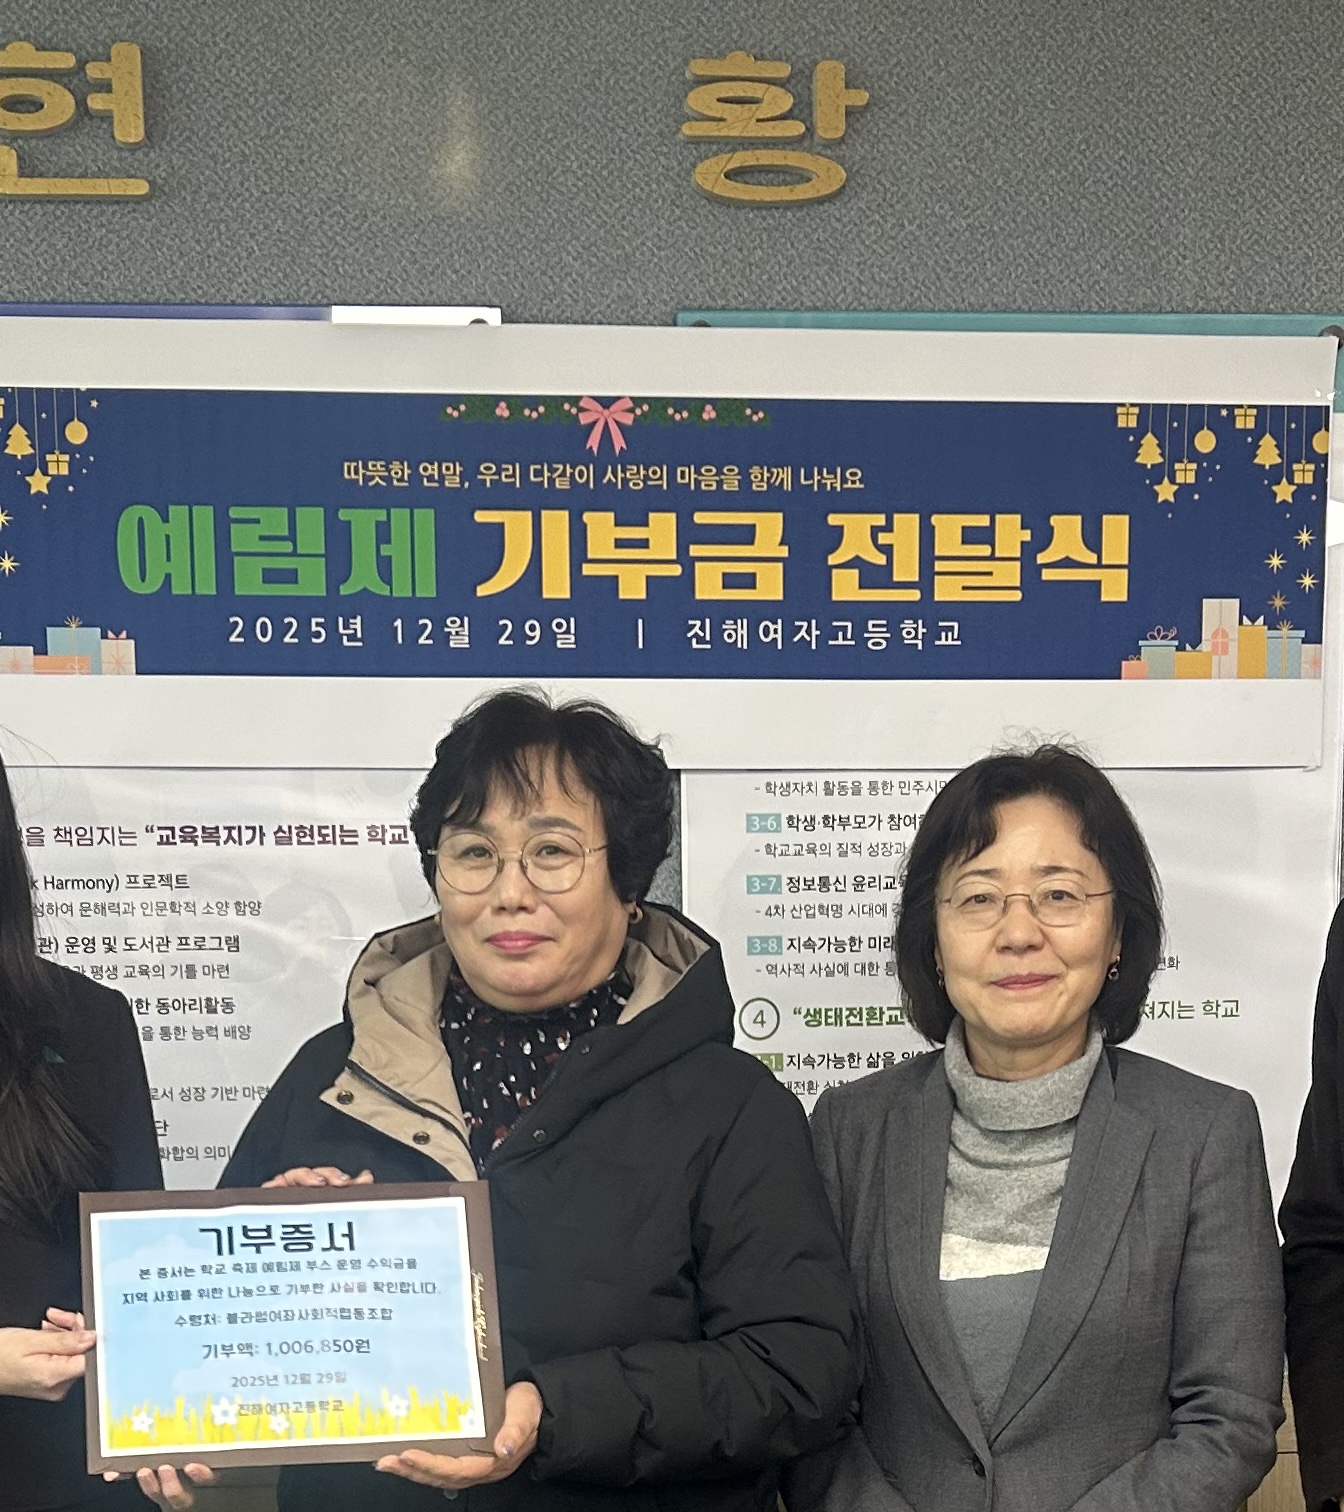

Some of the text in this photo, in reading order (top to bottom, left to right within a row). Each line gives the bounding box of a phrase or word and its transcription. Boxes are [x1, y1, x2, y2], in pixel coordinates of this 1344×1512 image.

[680, 50, 870, 202] 황
[343, 460, 865, 492] 따뜻한 연말, 우리 다같이 사랑의 마음을 함께 나눠요
[115, 503, 1131, 603] 예림제 기부금 전달식
[228, 614, 962, 651] 2025년 12월 29일 진해여자고등학교
[764, 780, 895, 797] 학생자치 활동을 통한
[751, 813, 883, 832] 3-6. 학생·학부모가
[53, 825, 138, 847] 책임지는
[273, 824, 359, 847] 실현되는
[764, 841, 907, 858] 학교교육의 질적 성장과
[44, 873, 190, 893] Harmony) 프로젝트
[751, 874, 847, 893] 3-7. 정보통신
[78, 900, 262, 918] 문해력과 인문학적 소양 함양
[764, 903, 786, 919] 4차
[790, 903, 843, 919] 산업혁명
[848, 903, 888, 919] 시대에
[64, 934, 241, 954] 운영 및 도서관 프로그램
[751, 936, 863, 954] 3-8. 지속가능한
[90, 963, 119, 981] 평생
[123, 963, 166, 980] 교육의
[202, 963, 230, 980] 마련
[765, 962, 805, 977] 역사적
[809, 961, 849, 977] 사실에
[854, 961, 880, 976] 대한
[156, 996, 236, 1015] 동아리활동
[1201, 999, 1240, 1019] 학교
[159, 1024, 252, 1041] 통한 능력 배양
[787, 1053, 862, 1070] 지속가능한
[178, 1086, 239, 1102] 성장 기반
[199, 1221, 355, 1257] 기부증서
[139, 1258, 417, 1280] 본 증서는 학교 축제 예림제 부스 운영 수익금을
[122, 1291, 148, 1305] 지역
[153, 1289, 192, 1303] 사회를
[197, 1287, 223, 1300] 위한
[286, 1282, 324, 1296] 기부한
[330, 1281, 367, 1294] 사실을
[373, 1280, 442, 1295] 확인합니다.
[202, 1338, 371, 1360] 기부액: 1,006,850원
[231, 1371, 347, 1388] 2025년 12월 29일
